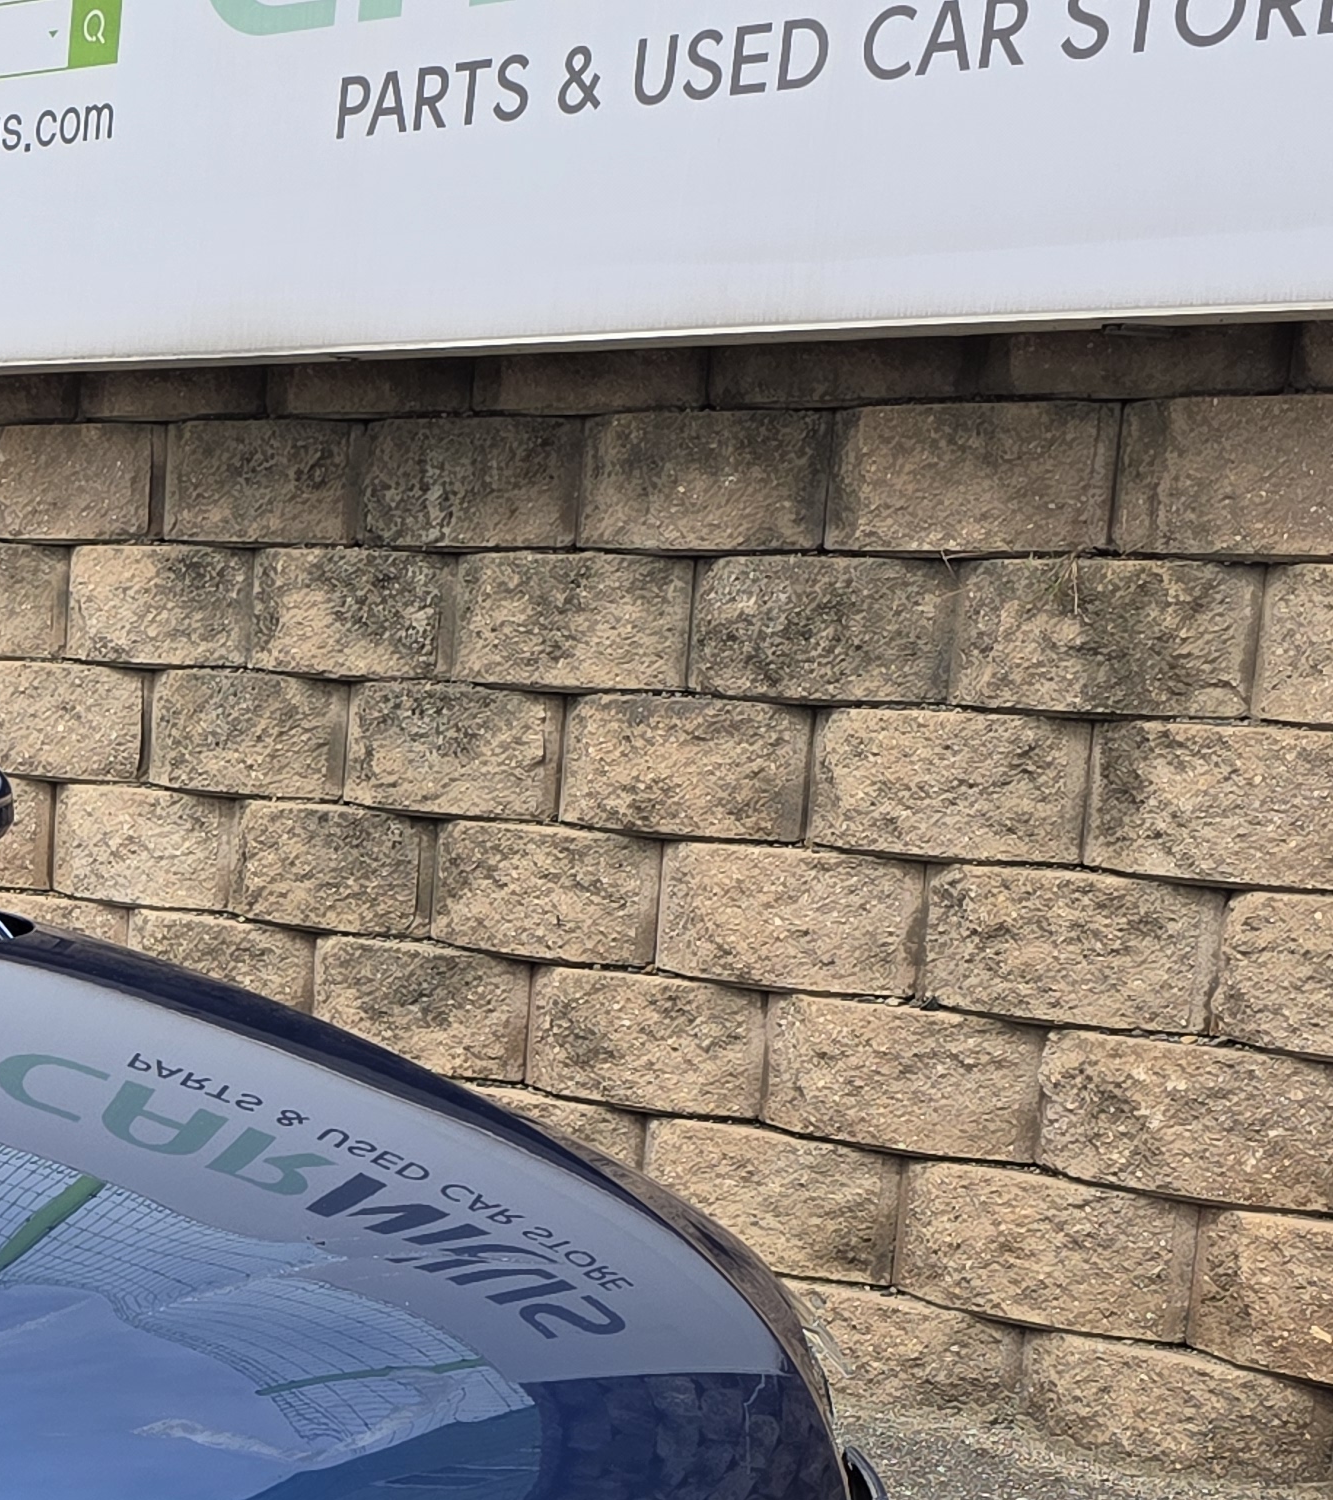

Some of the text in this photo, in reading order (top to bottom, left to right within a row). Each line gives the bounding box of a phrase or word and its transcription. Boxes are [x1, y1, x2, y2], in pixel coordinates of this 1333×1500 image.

[335, 53, 530, 139] PARTS
[557, 45, 601, 115] &
[633, 18, 829, 105] USED
[863, 0, 1029, 80] CAR
